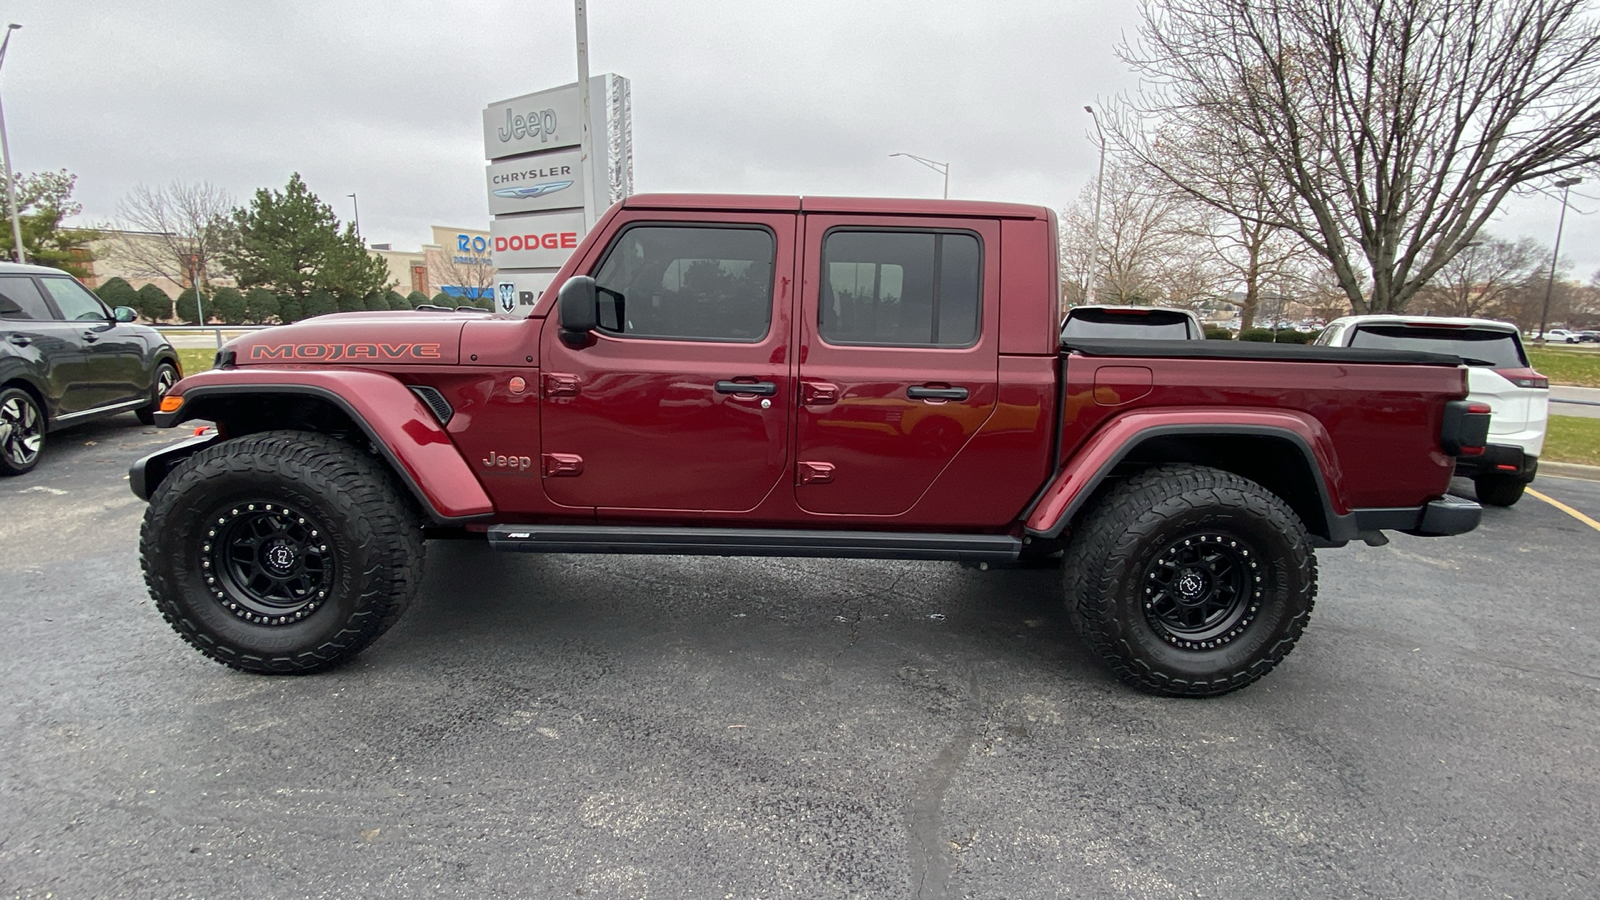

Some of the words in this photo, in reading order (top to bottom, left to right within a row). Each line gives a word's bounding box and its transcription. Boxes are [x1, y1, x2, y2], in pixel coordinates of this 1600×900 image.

[498, 108, 557, 143] Jeep
[492, 165, 571, 185] CHRYSLER
[495, 232, 578, 253] DODGE
[251, 343, 440, 361] MOJAVE
[482, 451, 531, 471] Jeep
